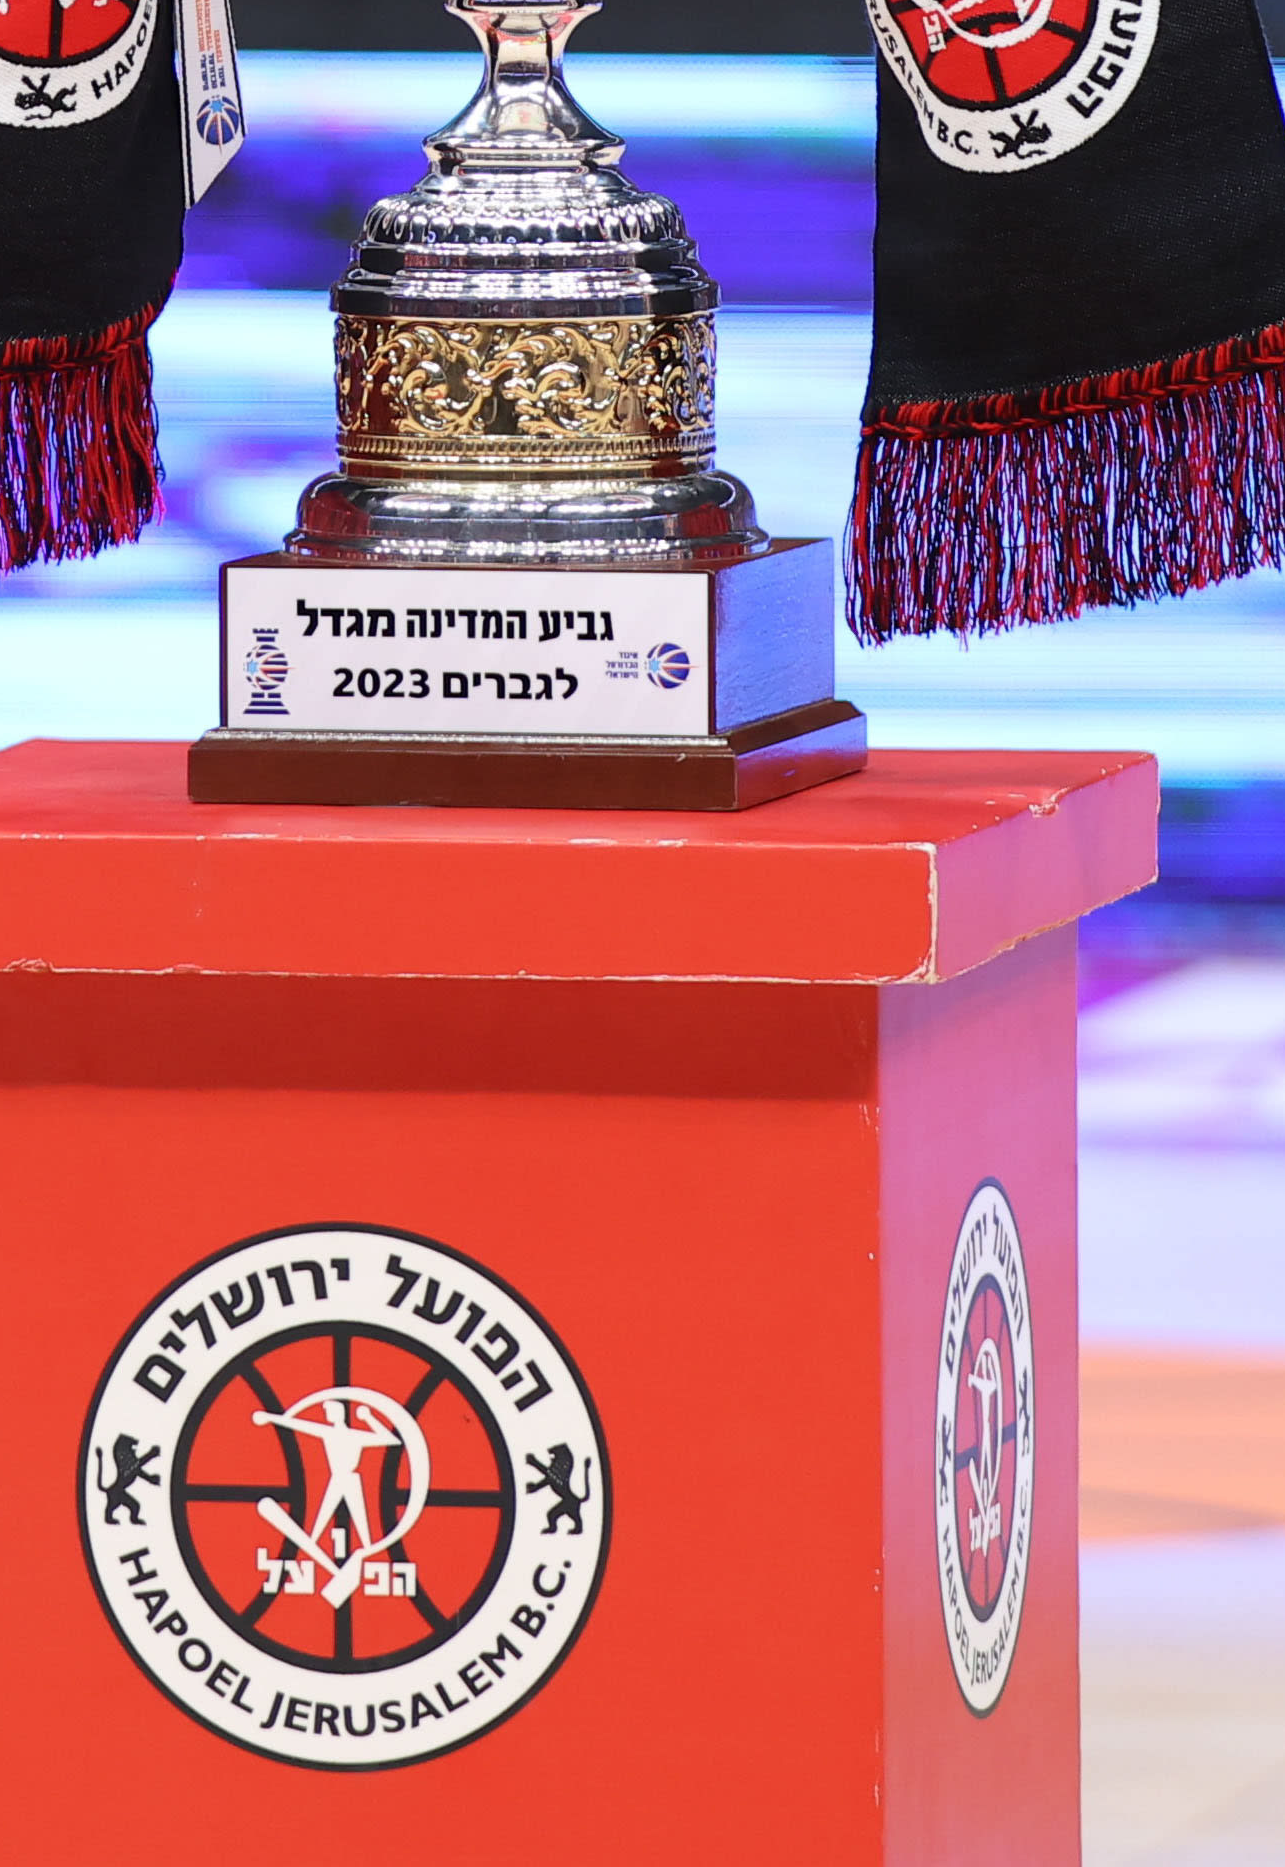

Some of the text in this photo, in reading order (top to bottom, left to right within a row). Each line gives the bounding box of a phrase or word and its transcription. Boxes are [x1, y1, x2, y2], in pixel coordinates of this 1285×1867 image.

[937, 122, 980, 156] B.C.
[295, 598, 615, 643] גביע המדינה מגדל
[332, 667, 580, 702] לגברים 2023
[133, 1253, 554, 1413] הפועל ירושלים
[992, 1203, 1025, 1341] הפועל
[119, 1546, 573, 1738] HAPOEL JERUSALEM B.C.
[942, 1525, 972, 1674] HAPOEL
[971, 1571, 1021, 1688] JERUSALEM
